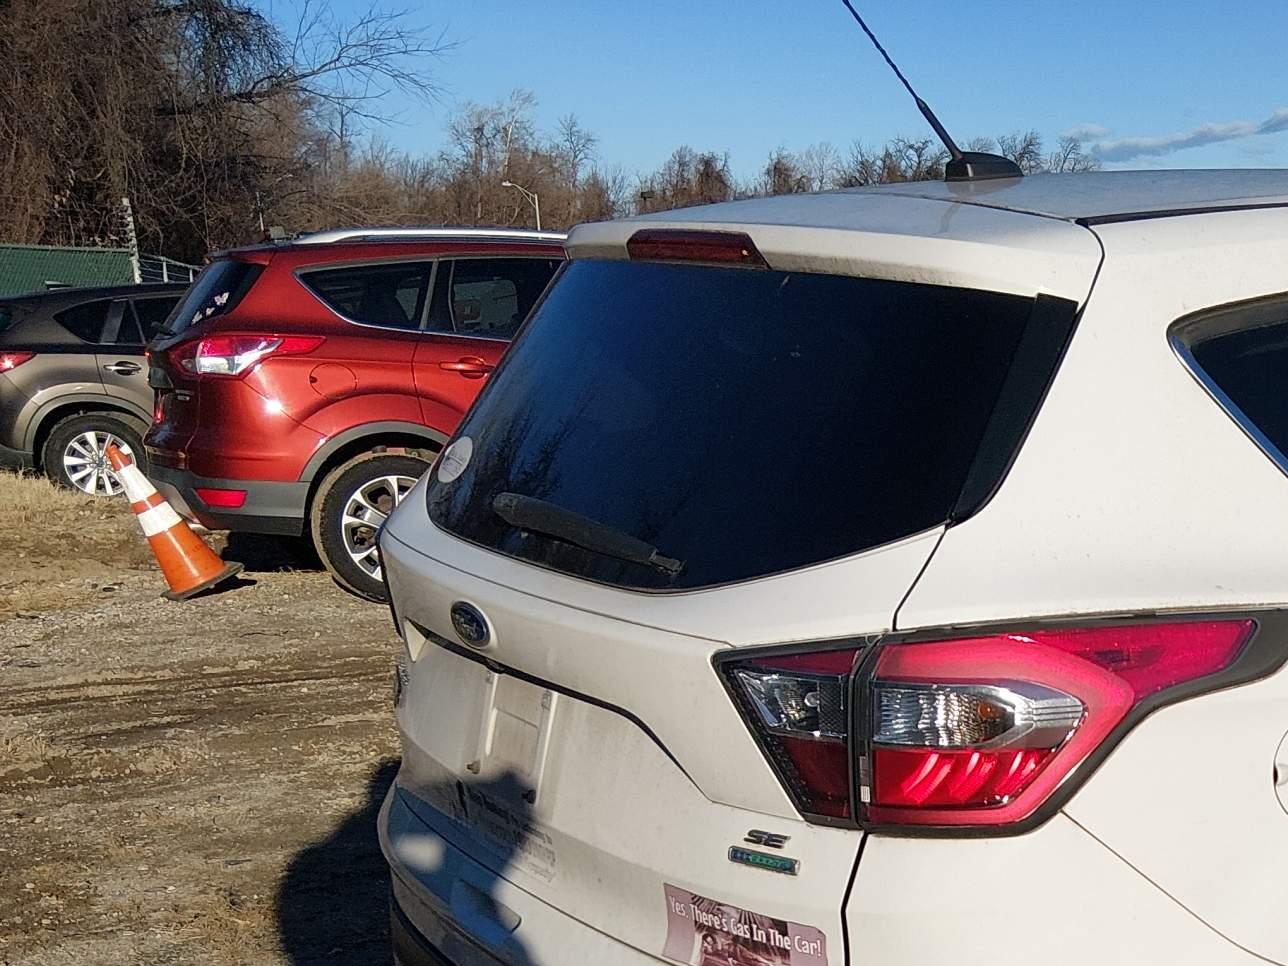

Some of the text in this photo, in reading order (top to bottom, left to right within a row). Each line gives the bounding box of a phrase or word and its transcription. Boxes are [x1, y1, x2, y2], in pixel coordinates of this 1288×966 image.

[743, 829, 792, 850] SE
[668, 895, 822, 957] Yes. There's Gas In The Car!
